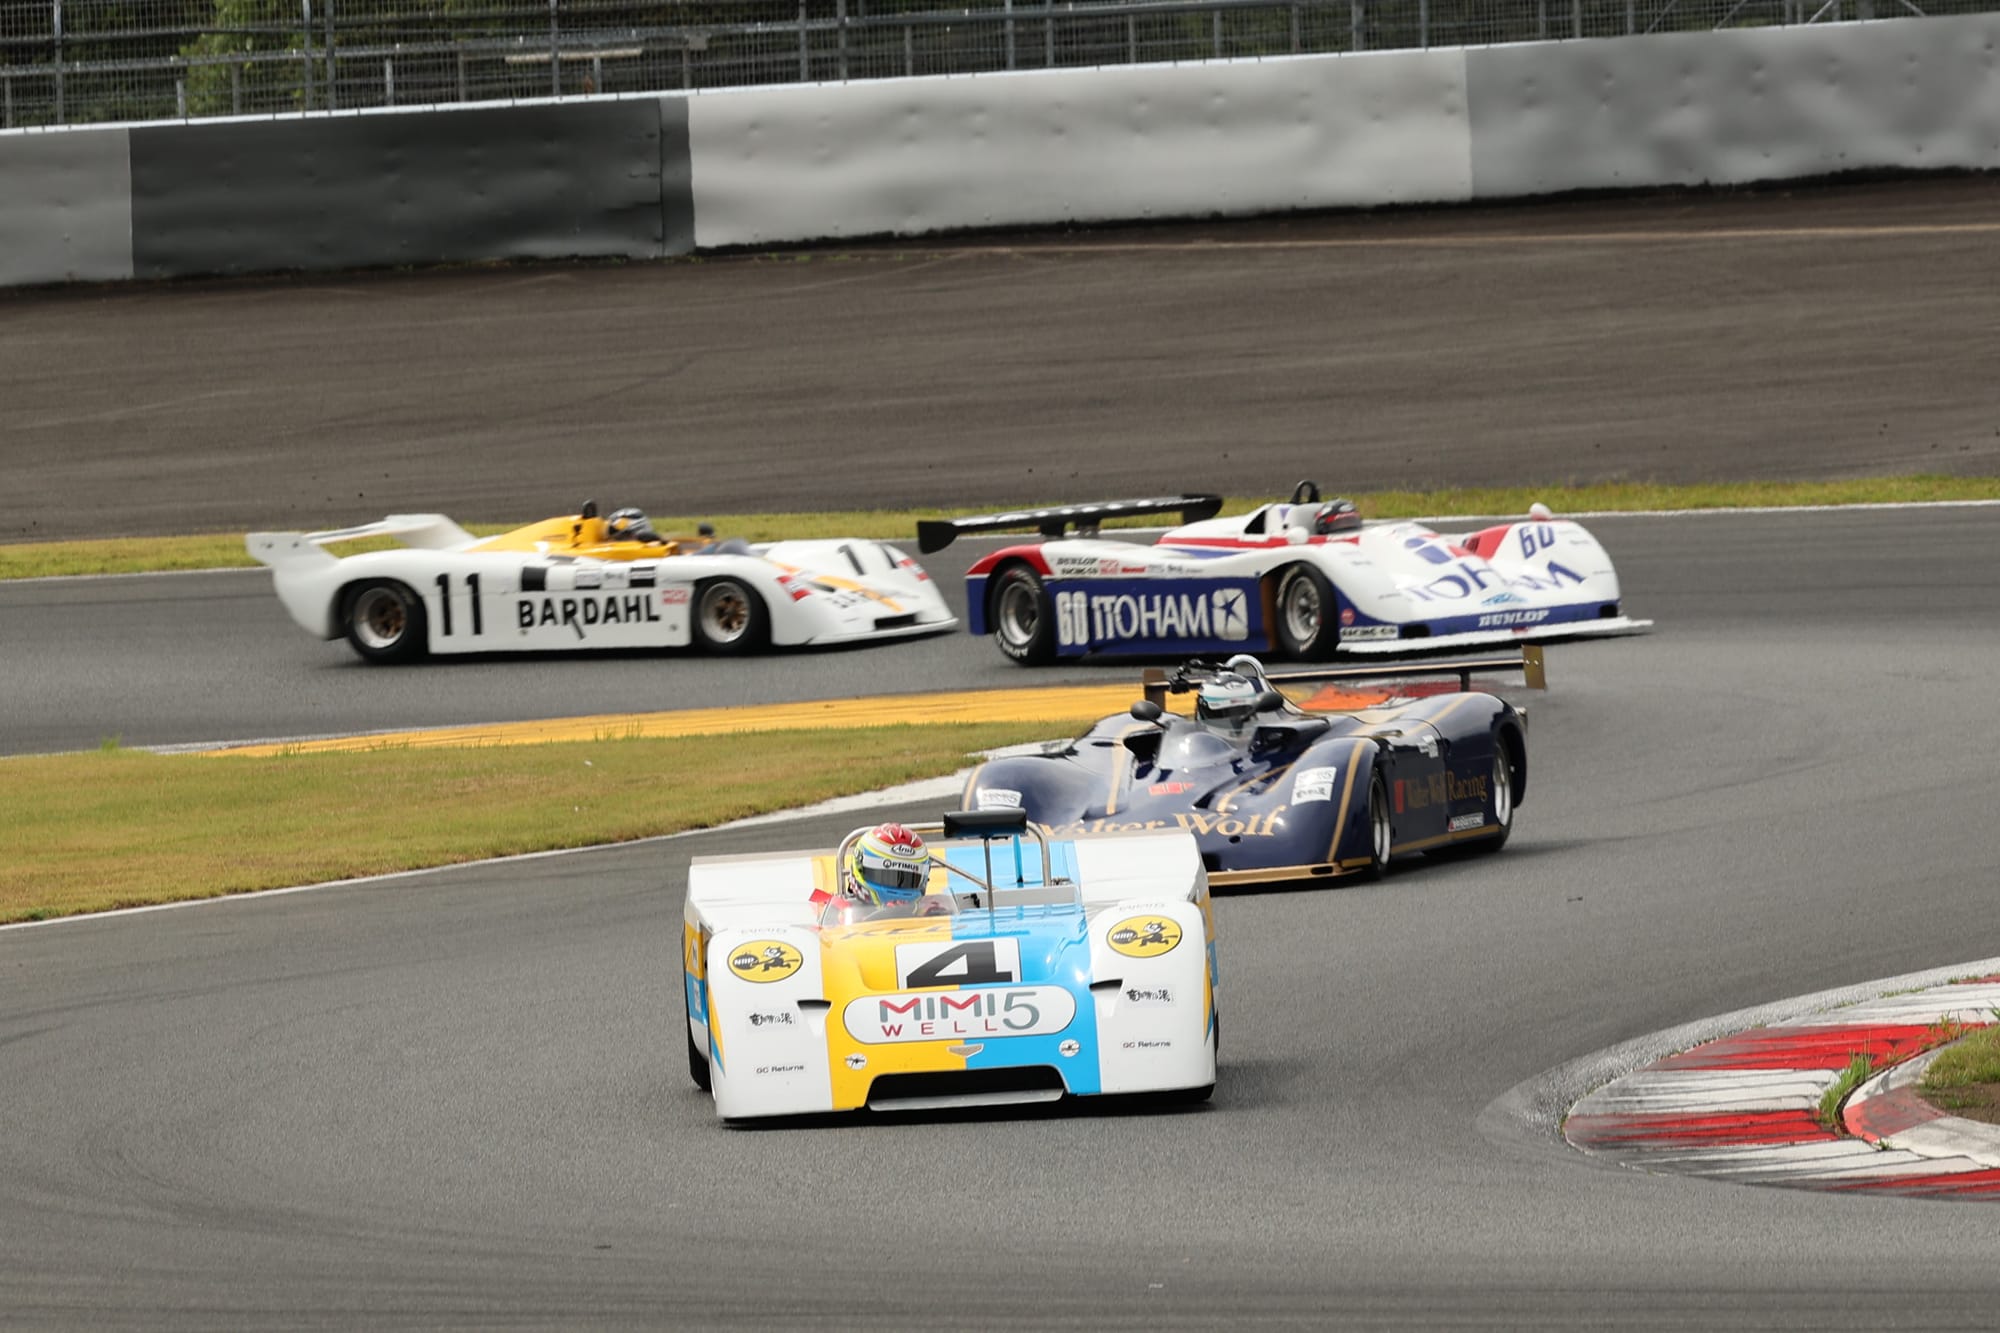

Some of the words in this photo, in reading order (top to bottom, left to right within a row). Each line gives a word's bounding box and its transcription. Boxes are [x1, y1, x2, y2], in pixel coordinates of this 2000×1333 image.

[1519, 524, 1555, 559] 60
[1405, 558, 1587, 602] OHAM
[435, 572, 483, 636] 11
[517, 594, 661, 640] BARDAHL
[1056, 591, 1090, 646] 60
[1091, 593, 1212, 641] ITOHAM
[1478, 610, 1550, 627] DUNLOP
[1172, 804, 1288, 837] Wolf
[882, 859, 920, 872] OPTIMUS
[893, 845, 913, 854] Arai
[906, 941, 1013, 989] 4
[879, 991, 1040, 1030] MIMI5
[881, 1018, 998, 1037] WELL
